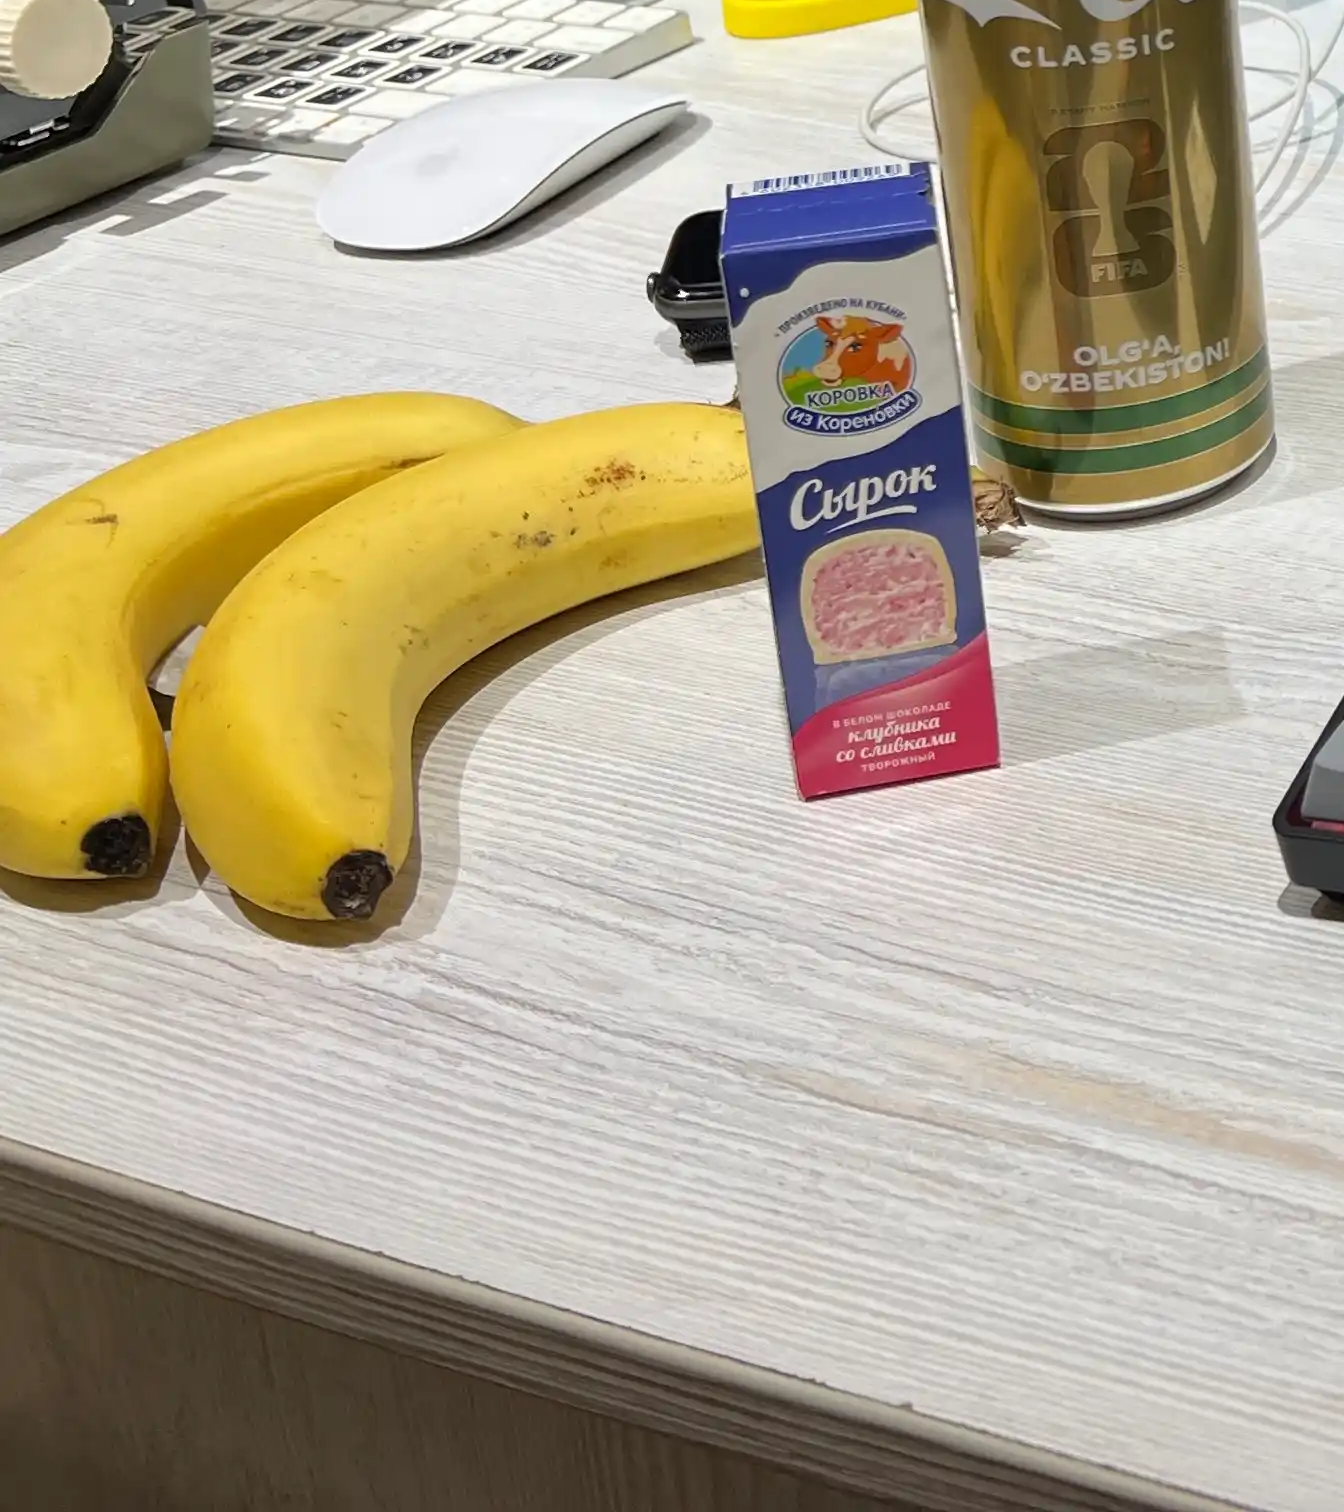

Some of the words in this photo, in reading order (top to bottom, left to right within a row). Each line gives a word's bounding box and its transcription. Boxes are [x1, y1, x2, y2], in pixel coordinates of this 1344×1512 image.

[1010, 27, 1176, 69] CLASSIC
[1091, 257, 1150, 284] FIFA
[778, 298, 848, 334] ПРОИЗВЕДЕНО
[850, 297, 864, 308] НА
[807, 382, 895, 408] КОРОВКА
[790, 463, 938, 532] Сырок
[843, 712, 884, 729] БЕЛОМ
[886, 700, 952, 720] ШОКОЛАДЕ
[847, 714, 941, 746] клубника
[835, 747, 856, 763] со
[859, 729, 957, 761] сливками
[860, 750, 937, 773] ТВОРОЖНЫЙ
